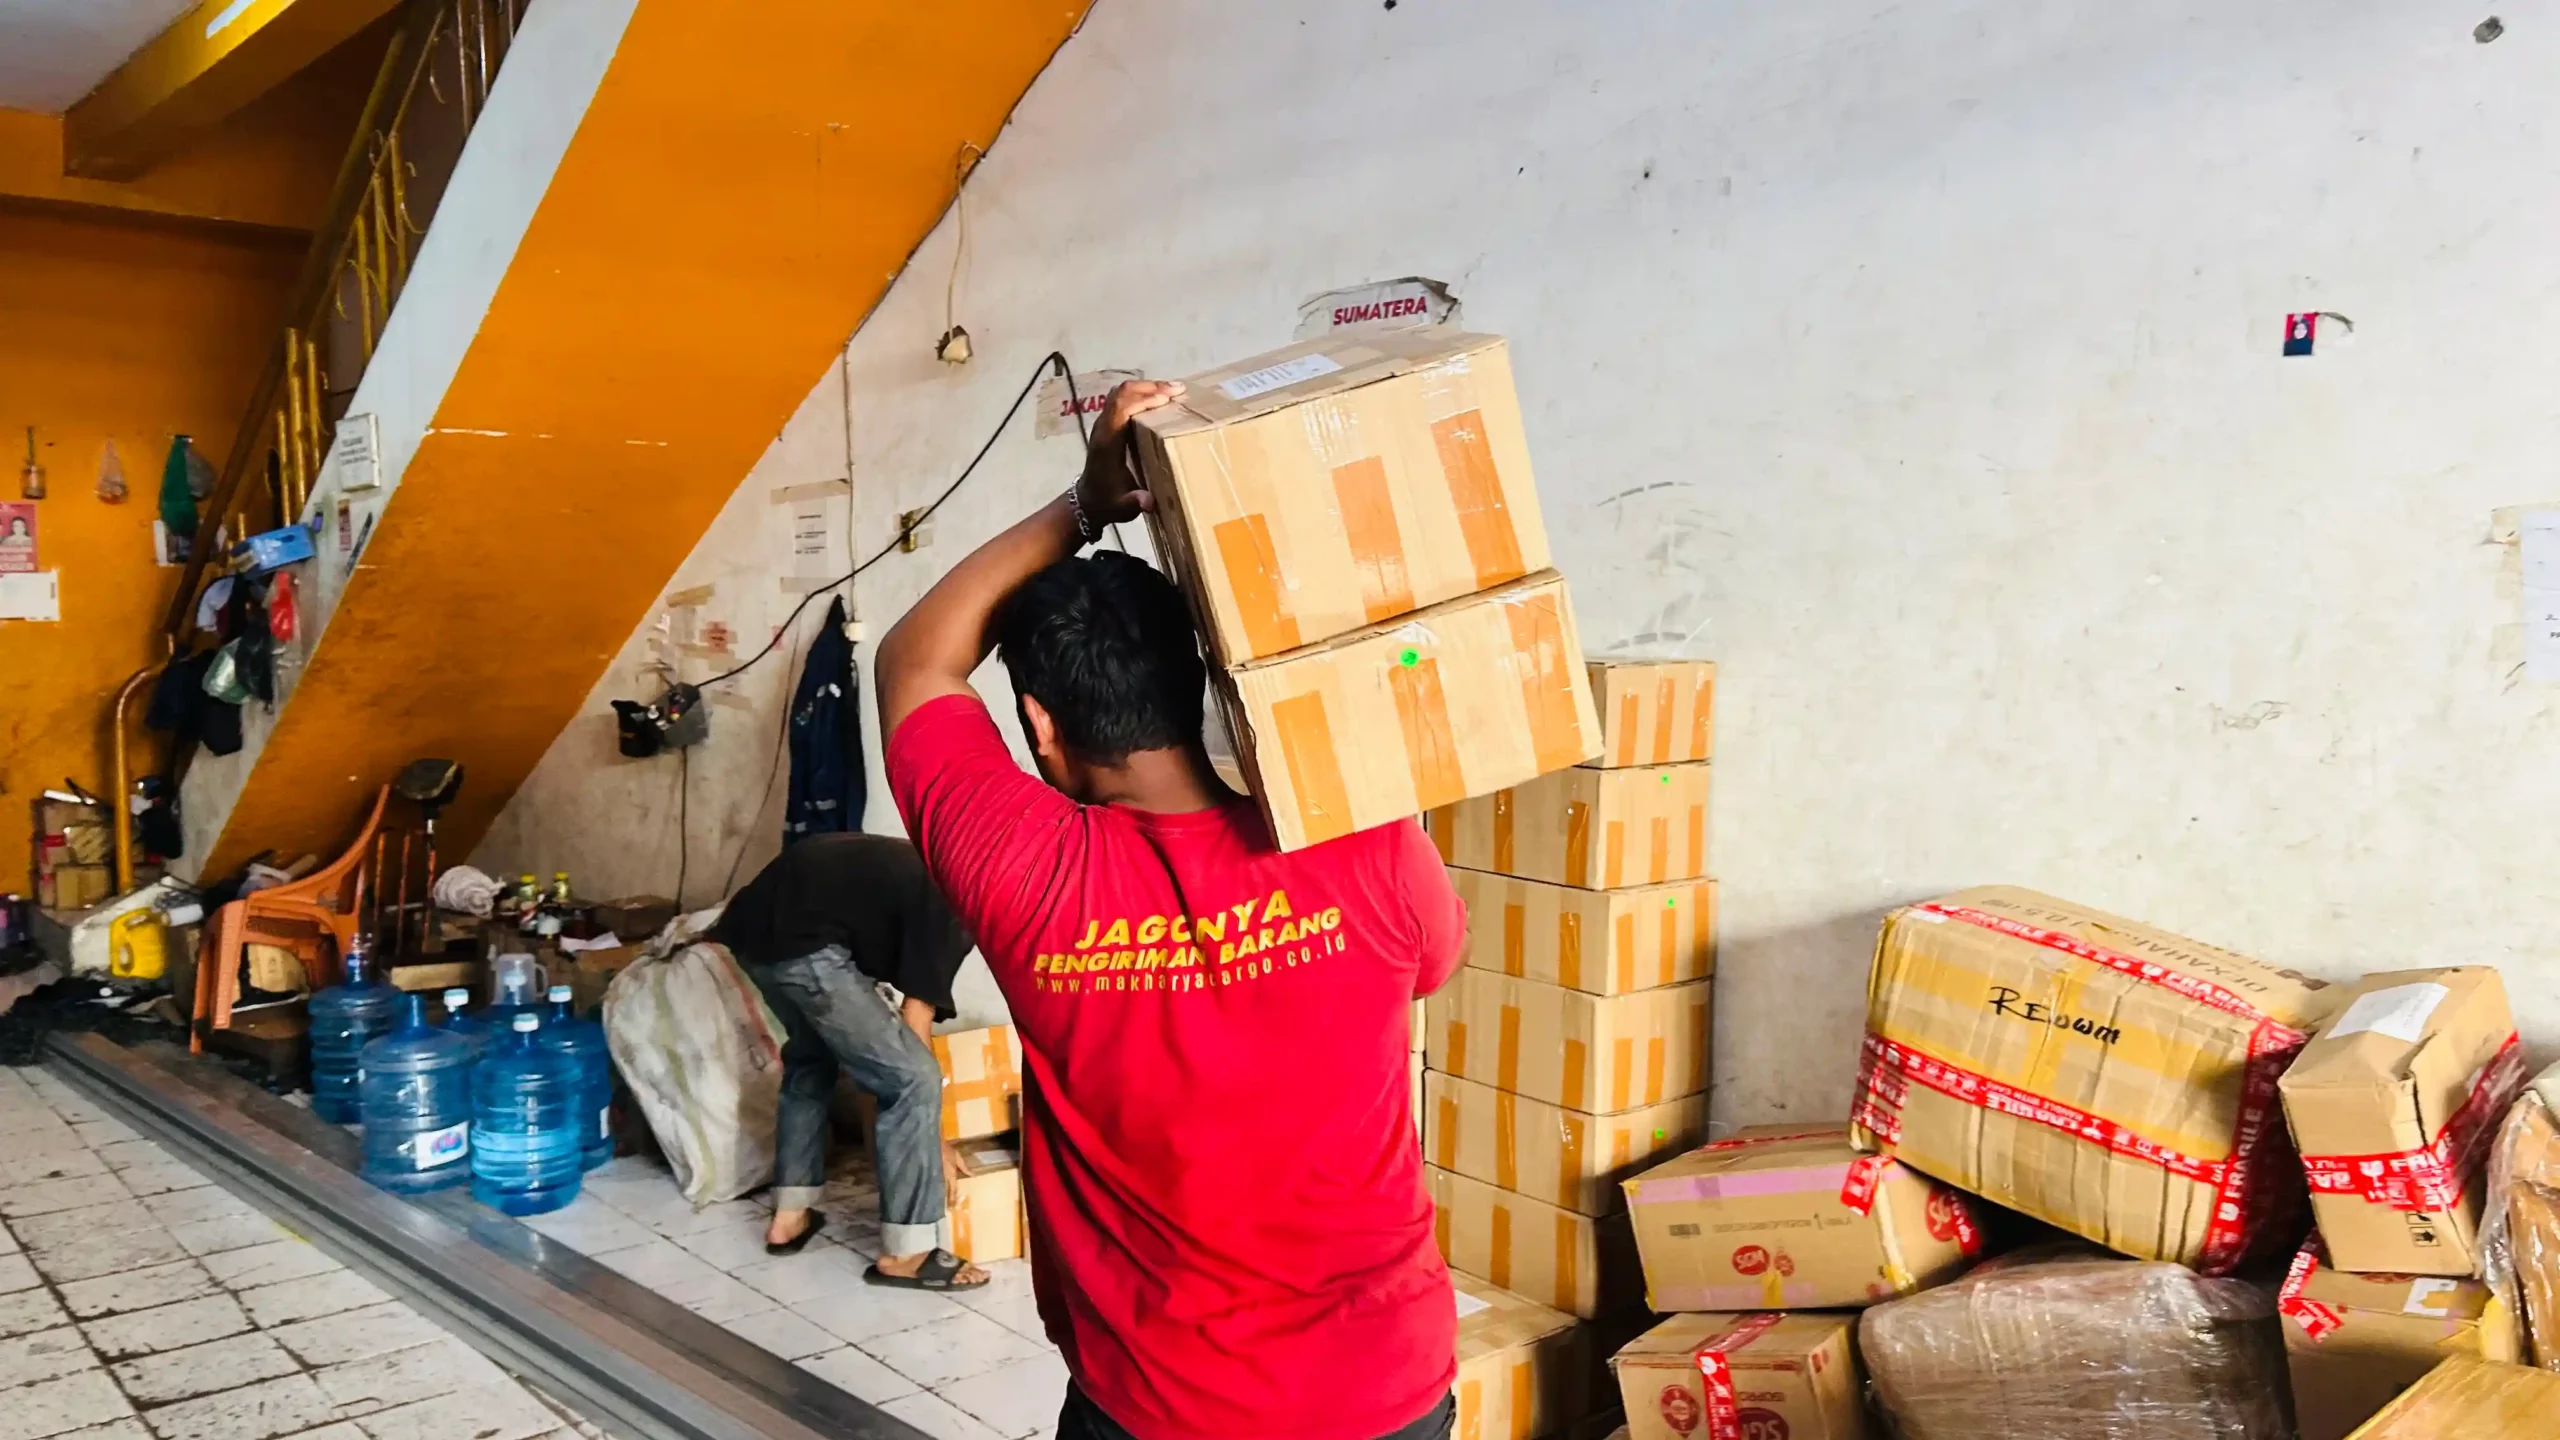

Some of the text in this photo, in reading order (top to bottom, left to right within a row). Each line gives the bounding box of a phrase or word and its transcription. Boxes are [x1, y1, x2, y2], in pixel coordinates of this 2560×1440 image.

[1333, 296, 1427, 325] SUMATERA
[1034, 906, 1342, 975] PENGIRIMAN BARANG
[1036, 932, 1346, 994] www.makharyacargo.co.id
